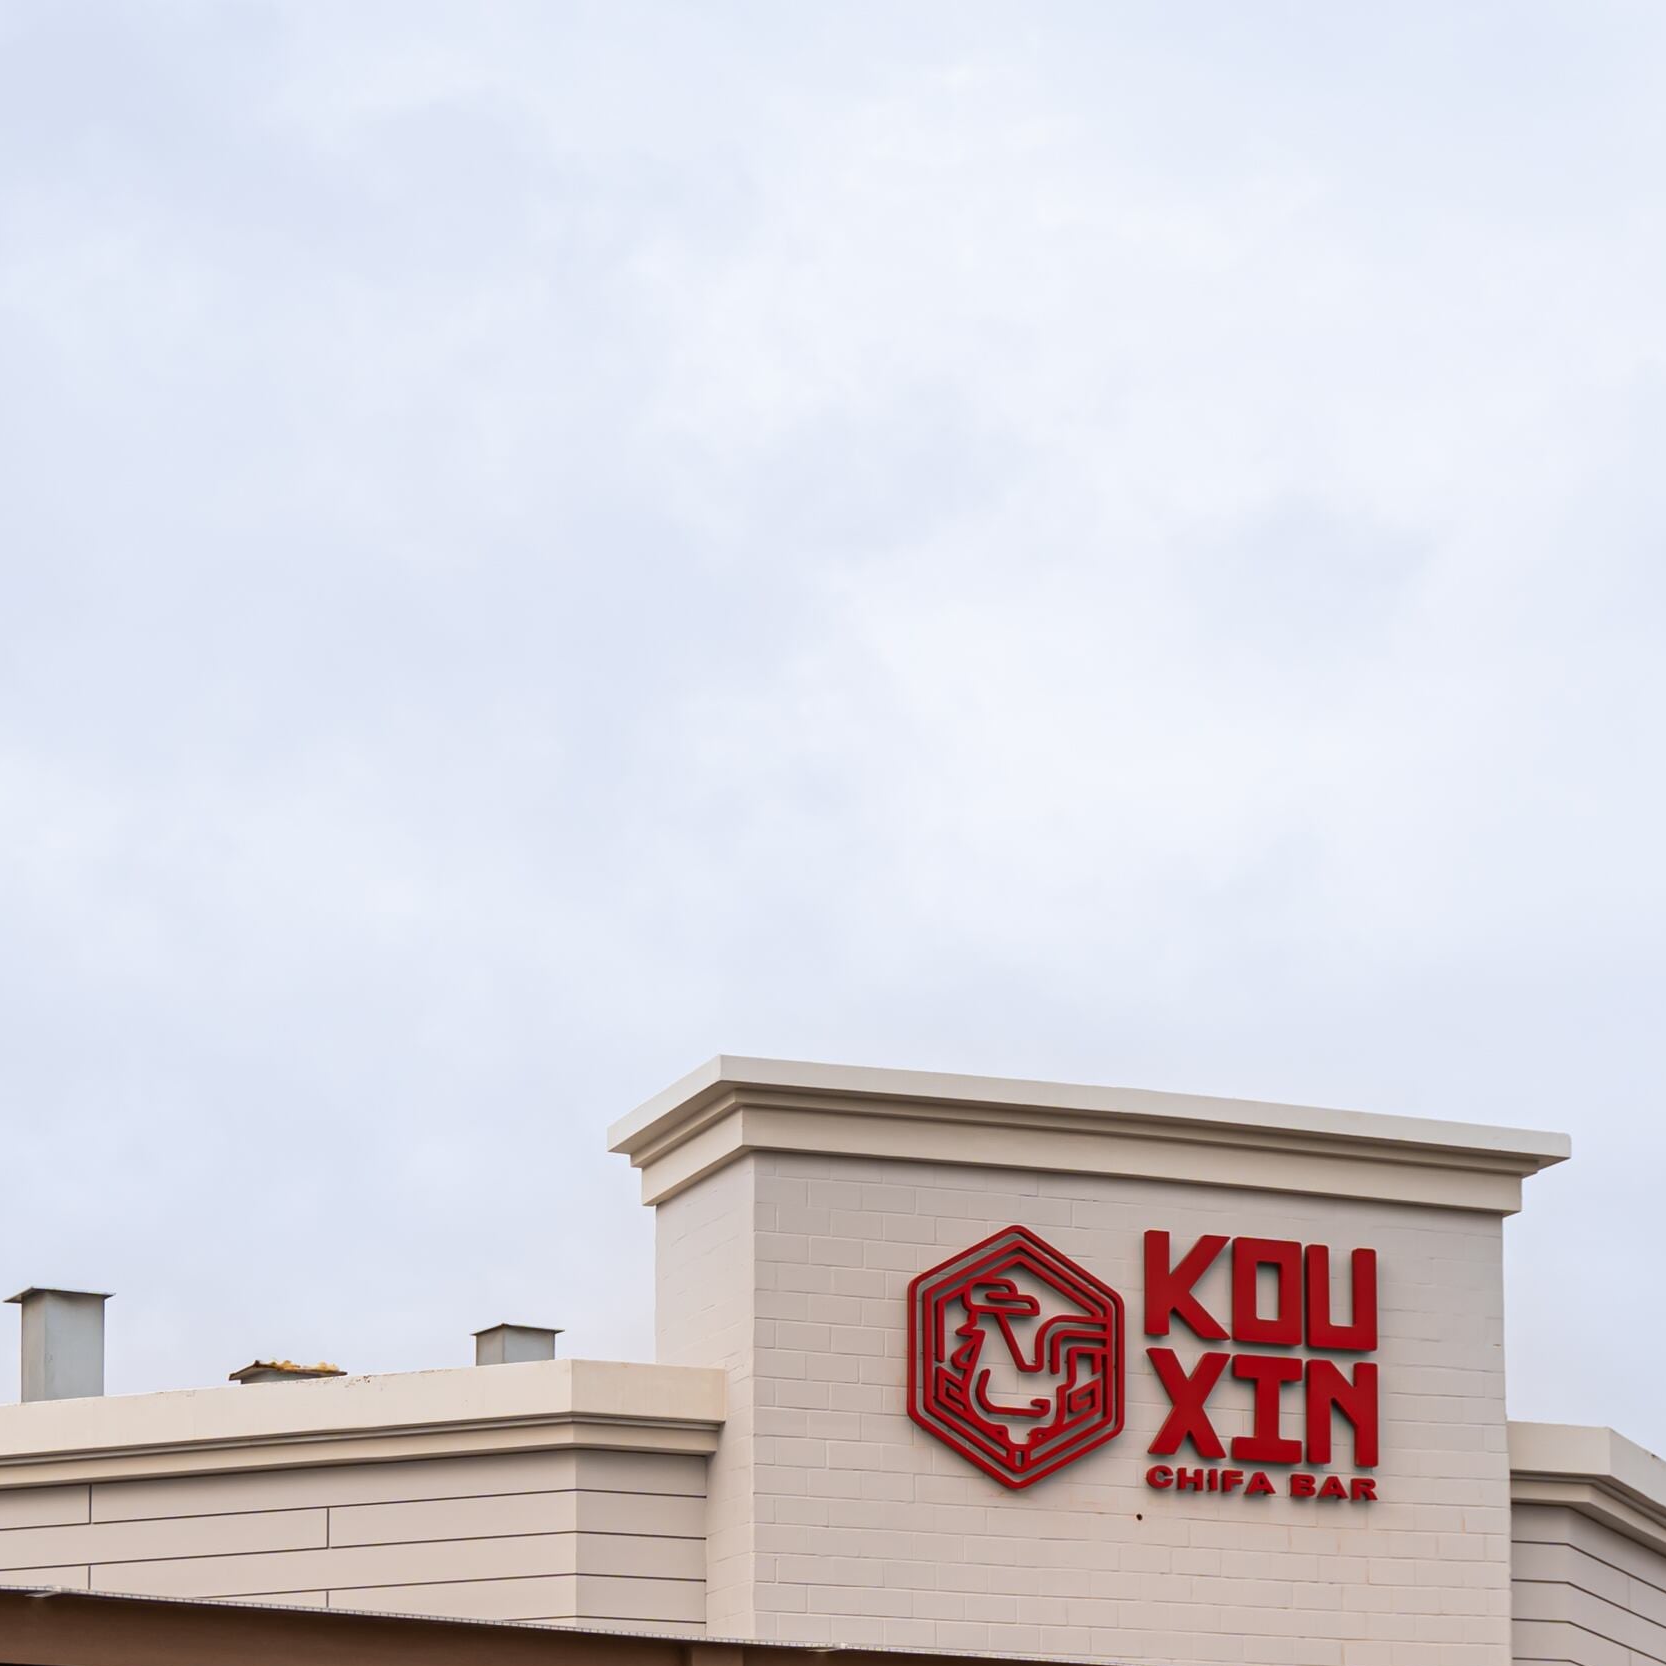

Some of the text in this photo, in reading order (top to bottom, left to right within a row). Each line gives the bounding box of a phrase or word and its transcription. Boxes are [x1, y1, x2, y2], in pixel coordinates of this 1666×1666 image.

[1144, 1229, 1377, 1351] KOU
[1145, 1347, 1378, 1467] XIN
[1146, 1464, 1378, 1501] CHIFA BAR
